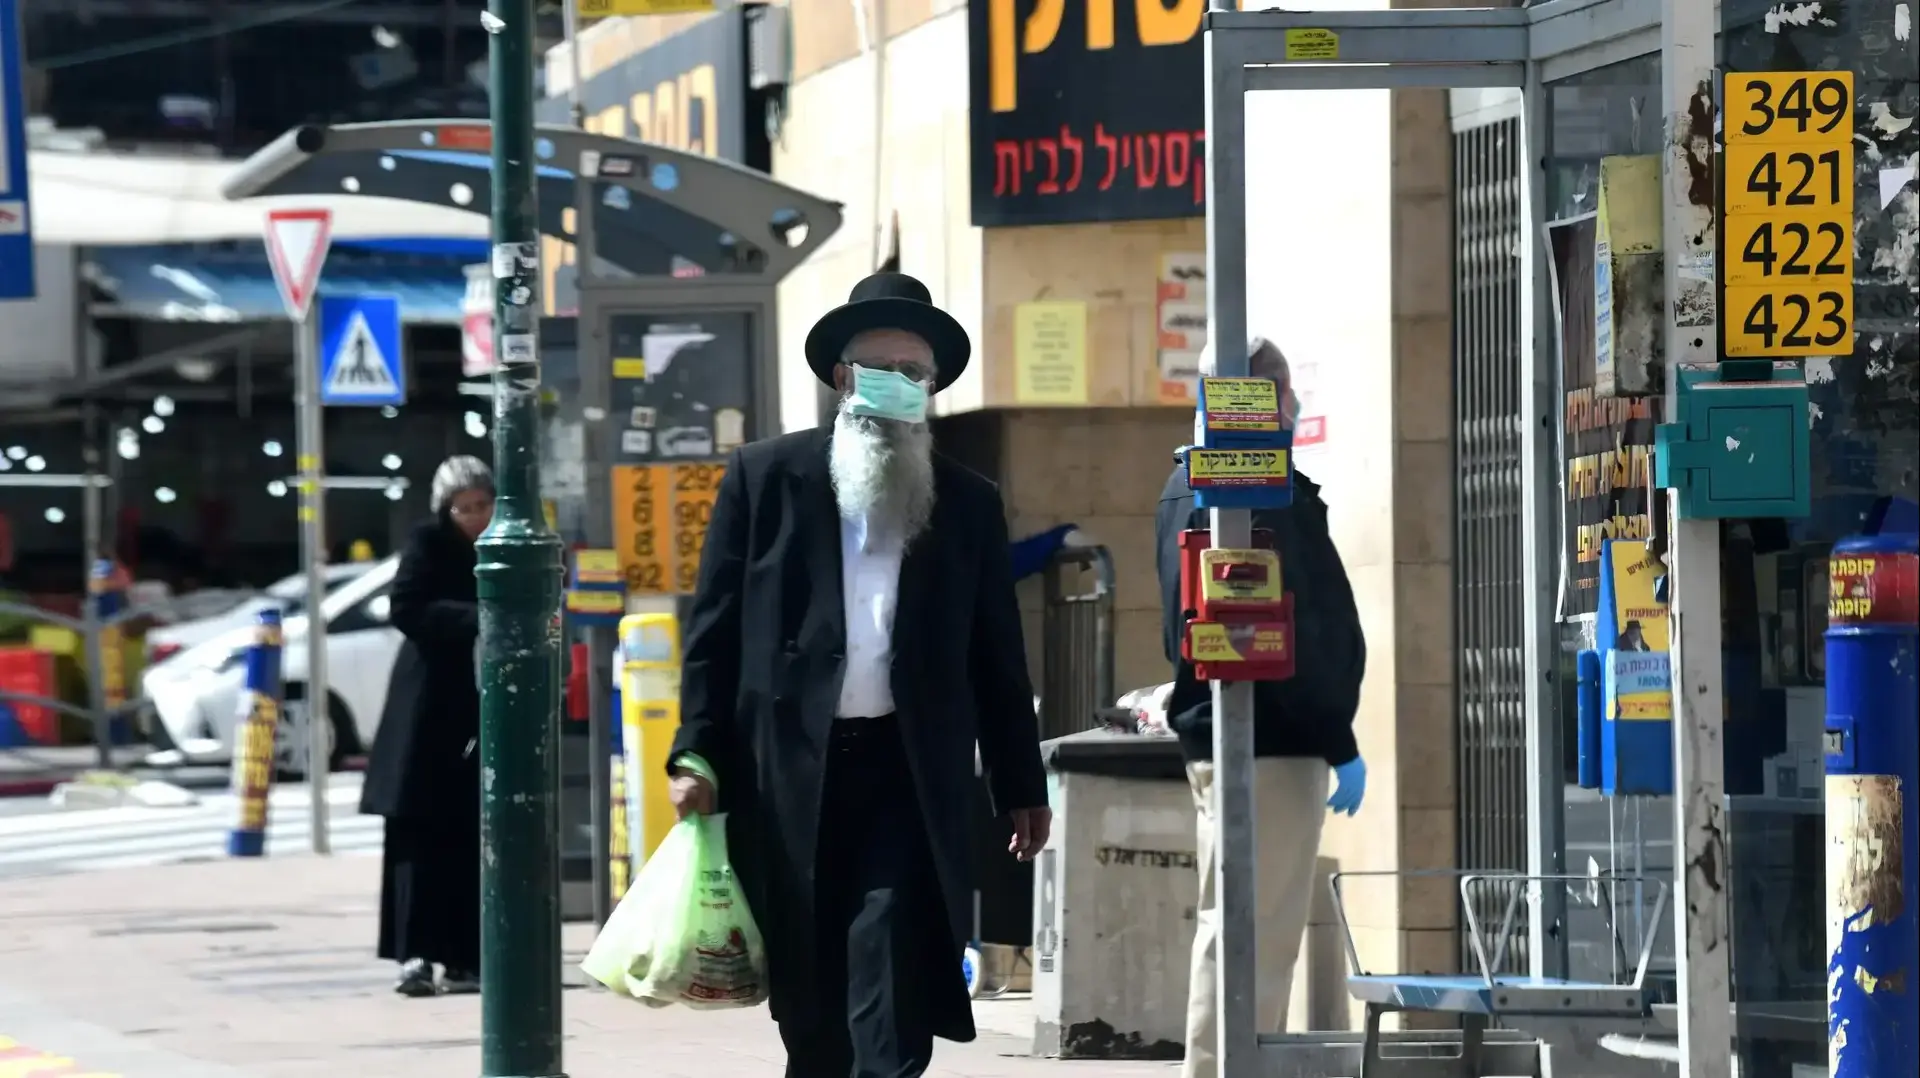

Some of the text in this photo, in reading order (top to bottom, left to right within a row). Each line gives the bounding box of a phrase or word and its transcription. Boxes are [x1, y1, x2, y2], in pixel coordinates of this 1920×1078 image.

[1742, 77, 1848, 135] 349
[993, 123, 1084, 197] לבית
[1746, 150, 1840, 207] 421
[1742, 221, 1846, 277] 422
[1743, 291, 1847, 350] 423
[1200, 452, 1277, 470] קופת צדקה
